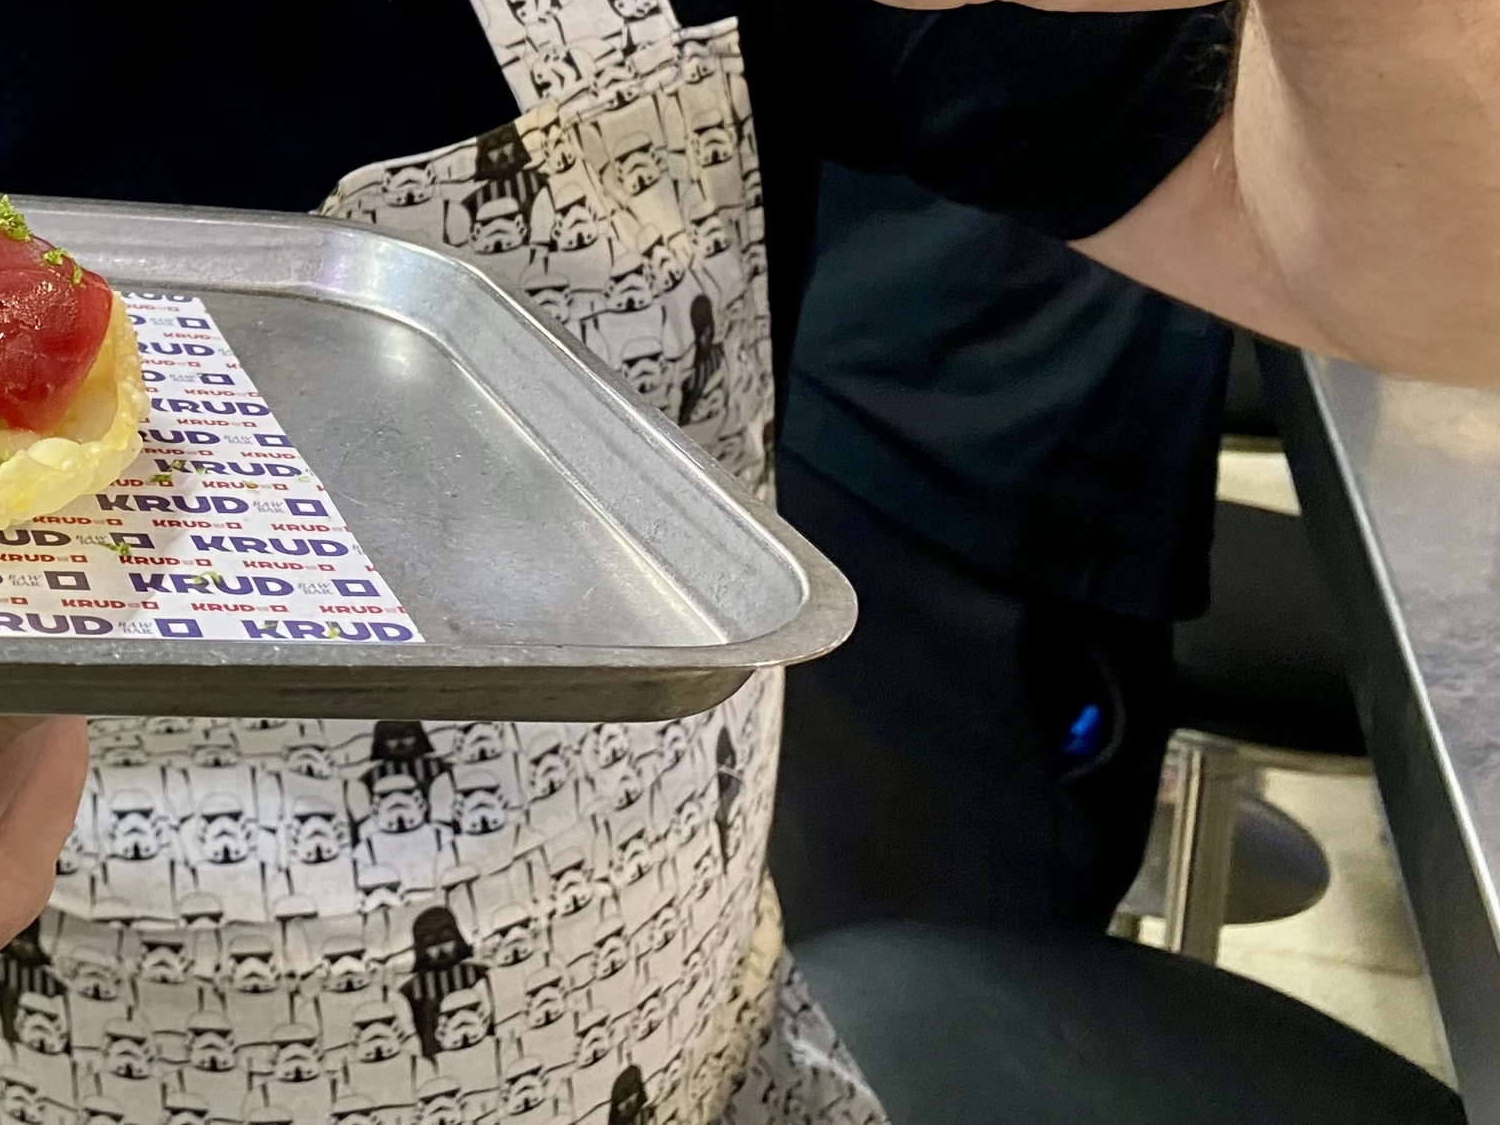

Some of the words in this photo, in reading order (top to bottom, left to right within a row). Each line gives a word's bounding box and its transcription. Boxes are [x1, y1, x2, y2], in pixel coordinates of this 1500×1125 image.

[177, 418, 228, 426] KRUD
[240, 452, 296, 460] KRUD
[154, 459, 302, 477] KRUD
[202, 481, 259, 490] KRUD
[96, 494, 249, 514] KRUD
[32, 516, 92, 525] KRUD
[152, 519, 211, 529] KRUD
[271, 523, 330, 532] KRUD
[190, 535, 348, 557] KRUD
[119, 555, 180, 566] KRUD
[242, 560, 304, 570] KRUD
[129, 573, 294, 597] KRUD
[61, 599, 126, 610] KRUD
[190, 603, 256, 613] KRUD
[318, 605, 383, 615] KRUD
[240, 619, 413, 642] KRUD
